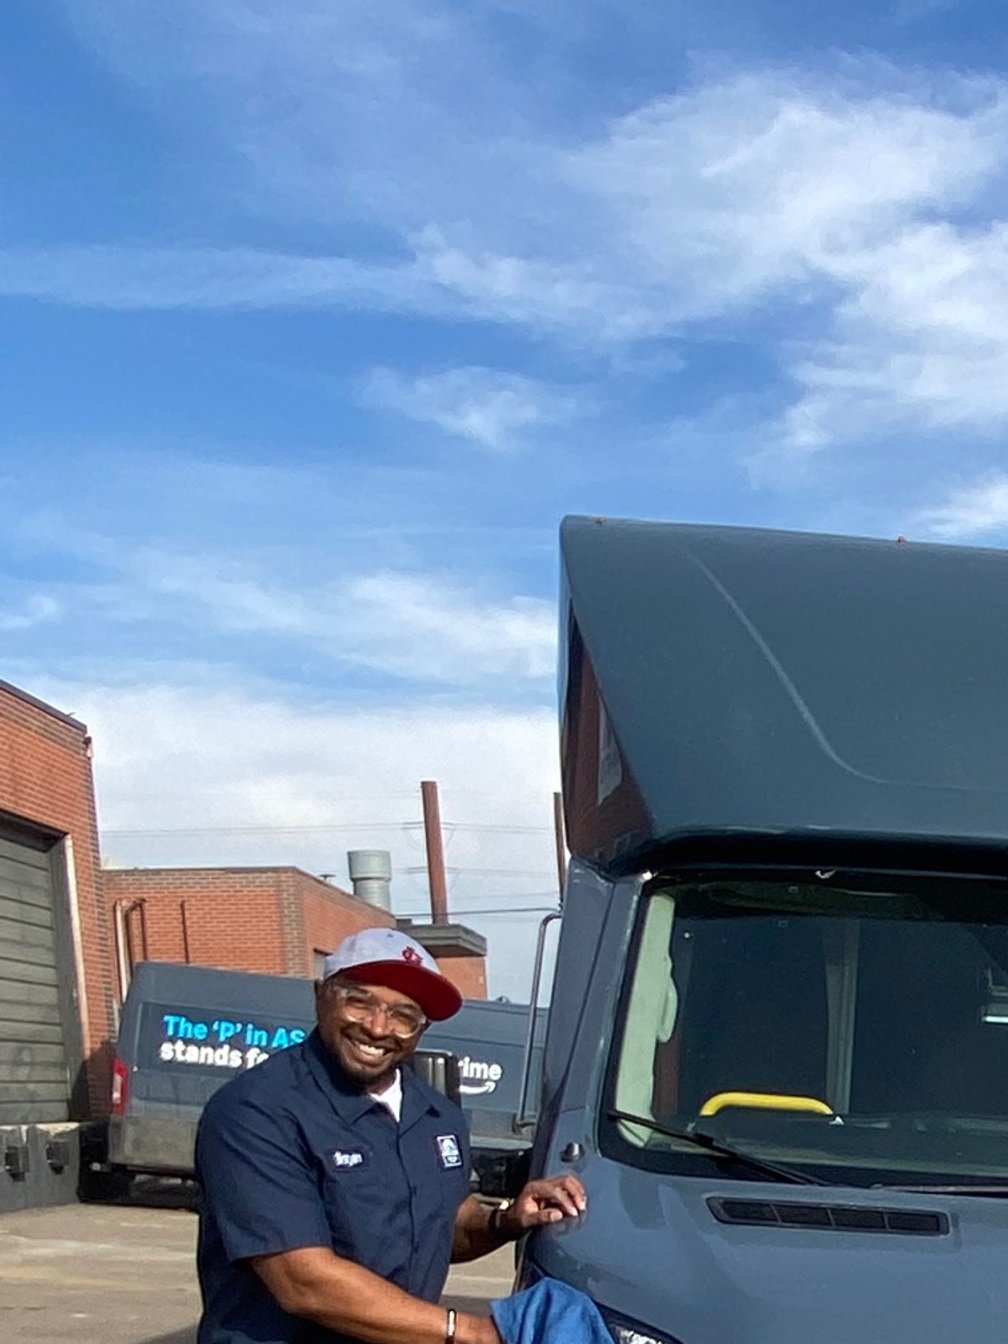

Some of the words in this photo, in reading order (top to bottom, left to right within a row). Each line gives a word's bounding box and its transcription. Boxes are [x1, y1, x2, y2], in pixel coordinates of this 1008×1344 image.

[163, 1014, 208, 1041] The
[212, 1020, 243, 1042] ‘P’
[245, 1023, 268, 1047] in
[160, 1039, 243, 1068] stands
[458, 1056, 502, 1080] ime
